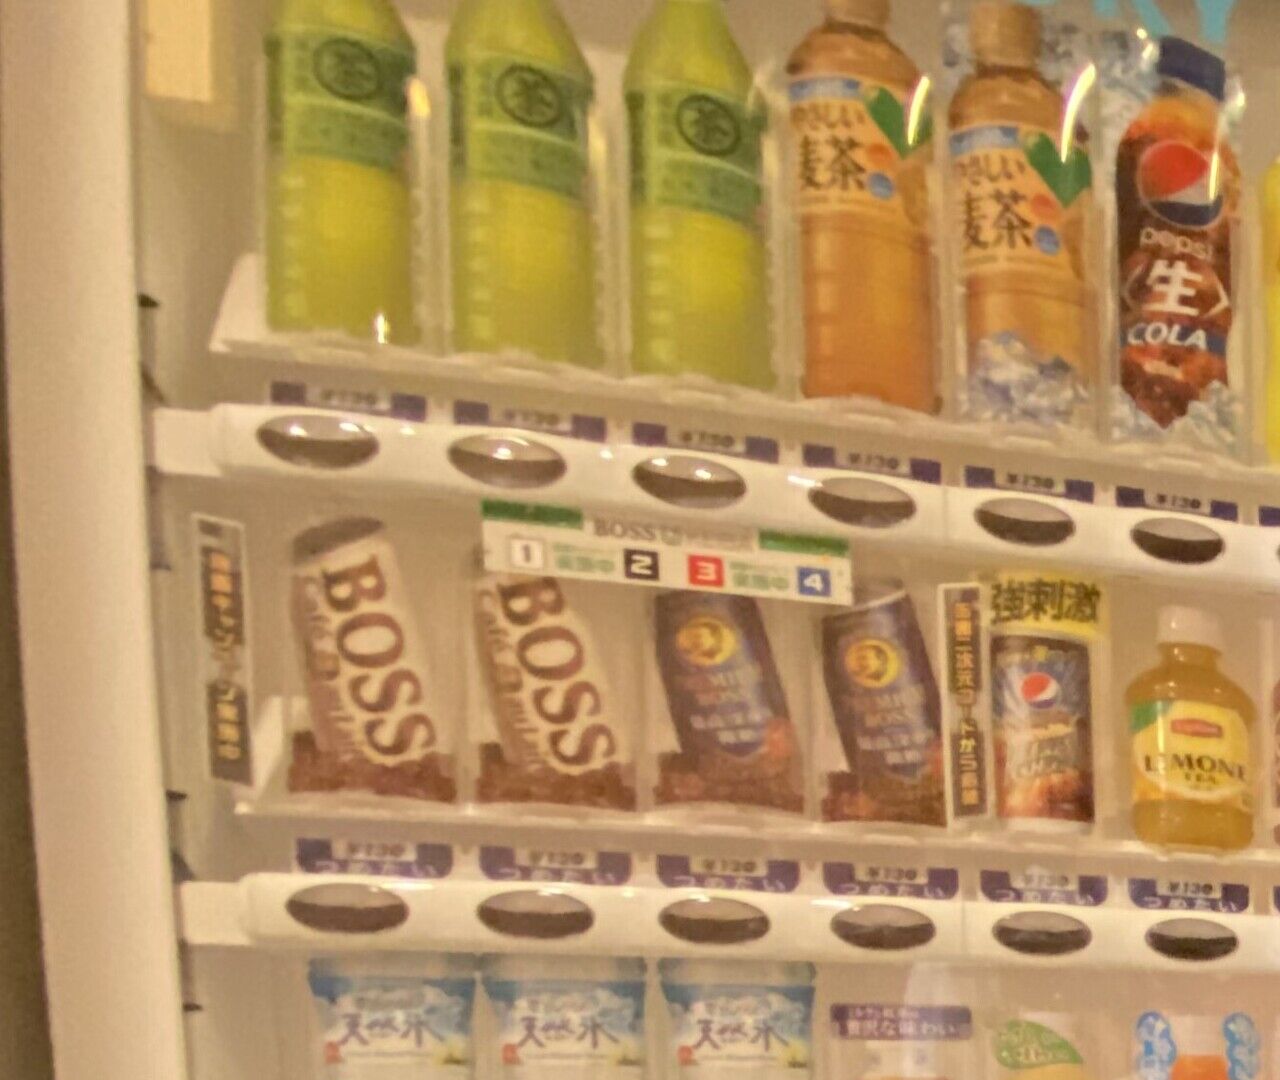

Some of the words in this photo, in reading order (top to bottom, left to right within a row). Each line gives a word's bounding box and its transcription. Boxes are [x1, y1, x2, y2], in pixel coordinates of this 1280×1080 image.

[1146, 259, 1200, 316] 生
[1127, 321, 1209, 352] COLA
[630, 554, 654, 576] 2
[695, 560, 720, 582] 3
[803, 573, 826, 593] 4
[322, 553, 437, 767] BOSS
[499, 577, 617, 776] BOSS
